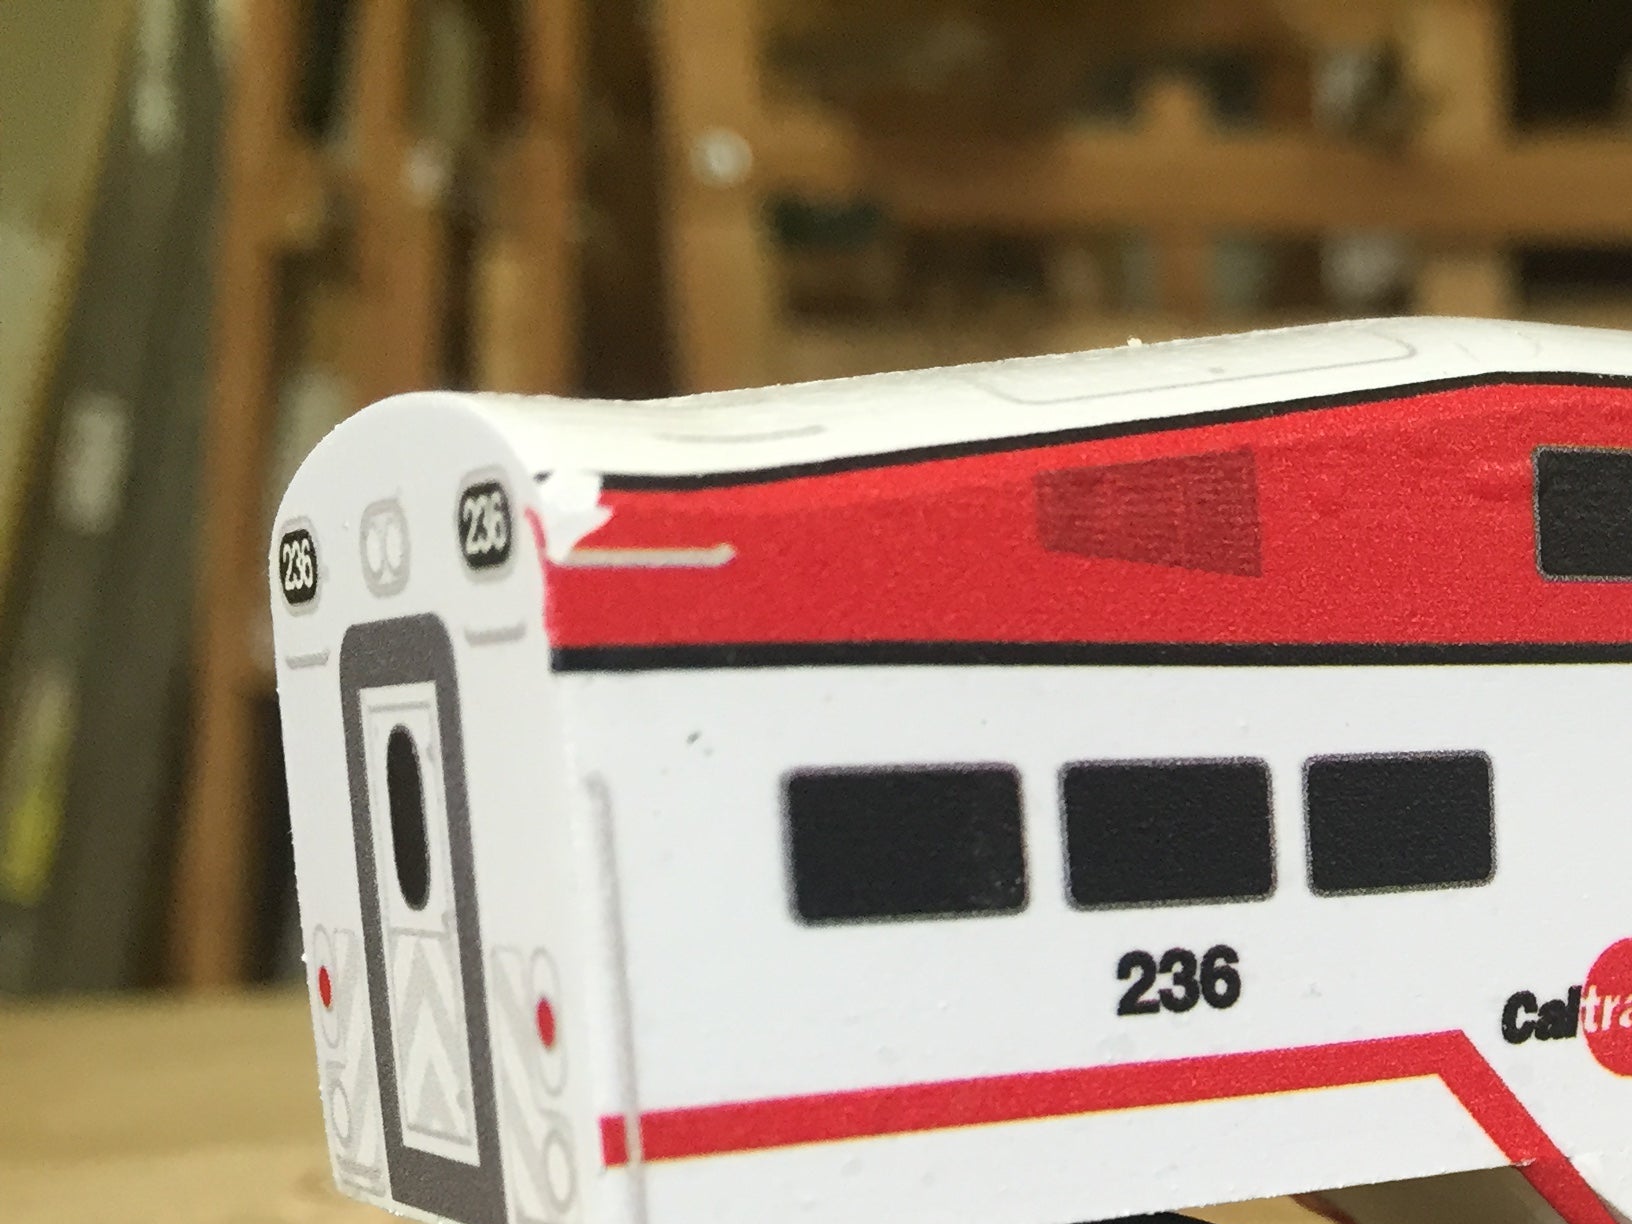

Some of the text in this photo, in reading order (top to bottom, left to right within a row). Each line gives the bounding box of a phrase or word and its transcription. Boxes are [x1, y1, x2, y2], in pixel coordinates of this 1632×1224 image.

[464, 491, 507, 554] 236
[283, 538, 313, 591] 236
[1117, 944, 1241, 1015] 236
